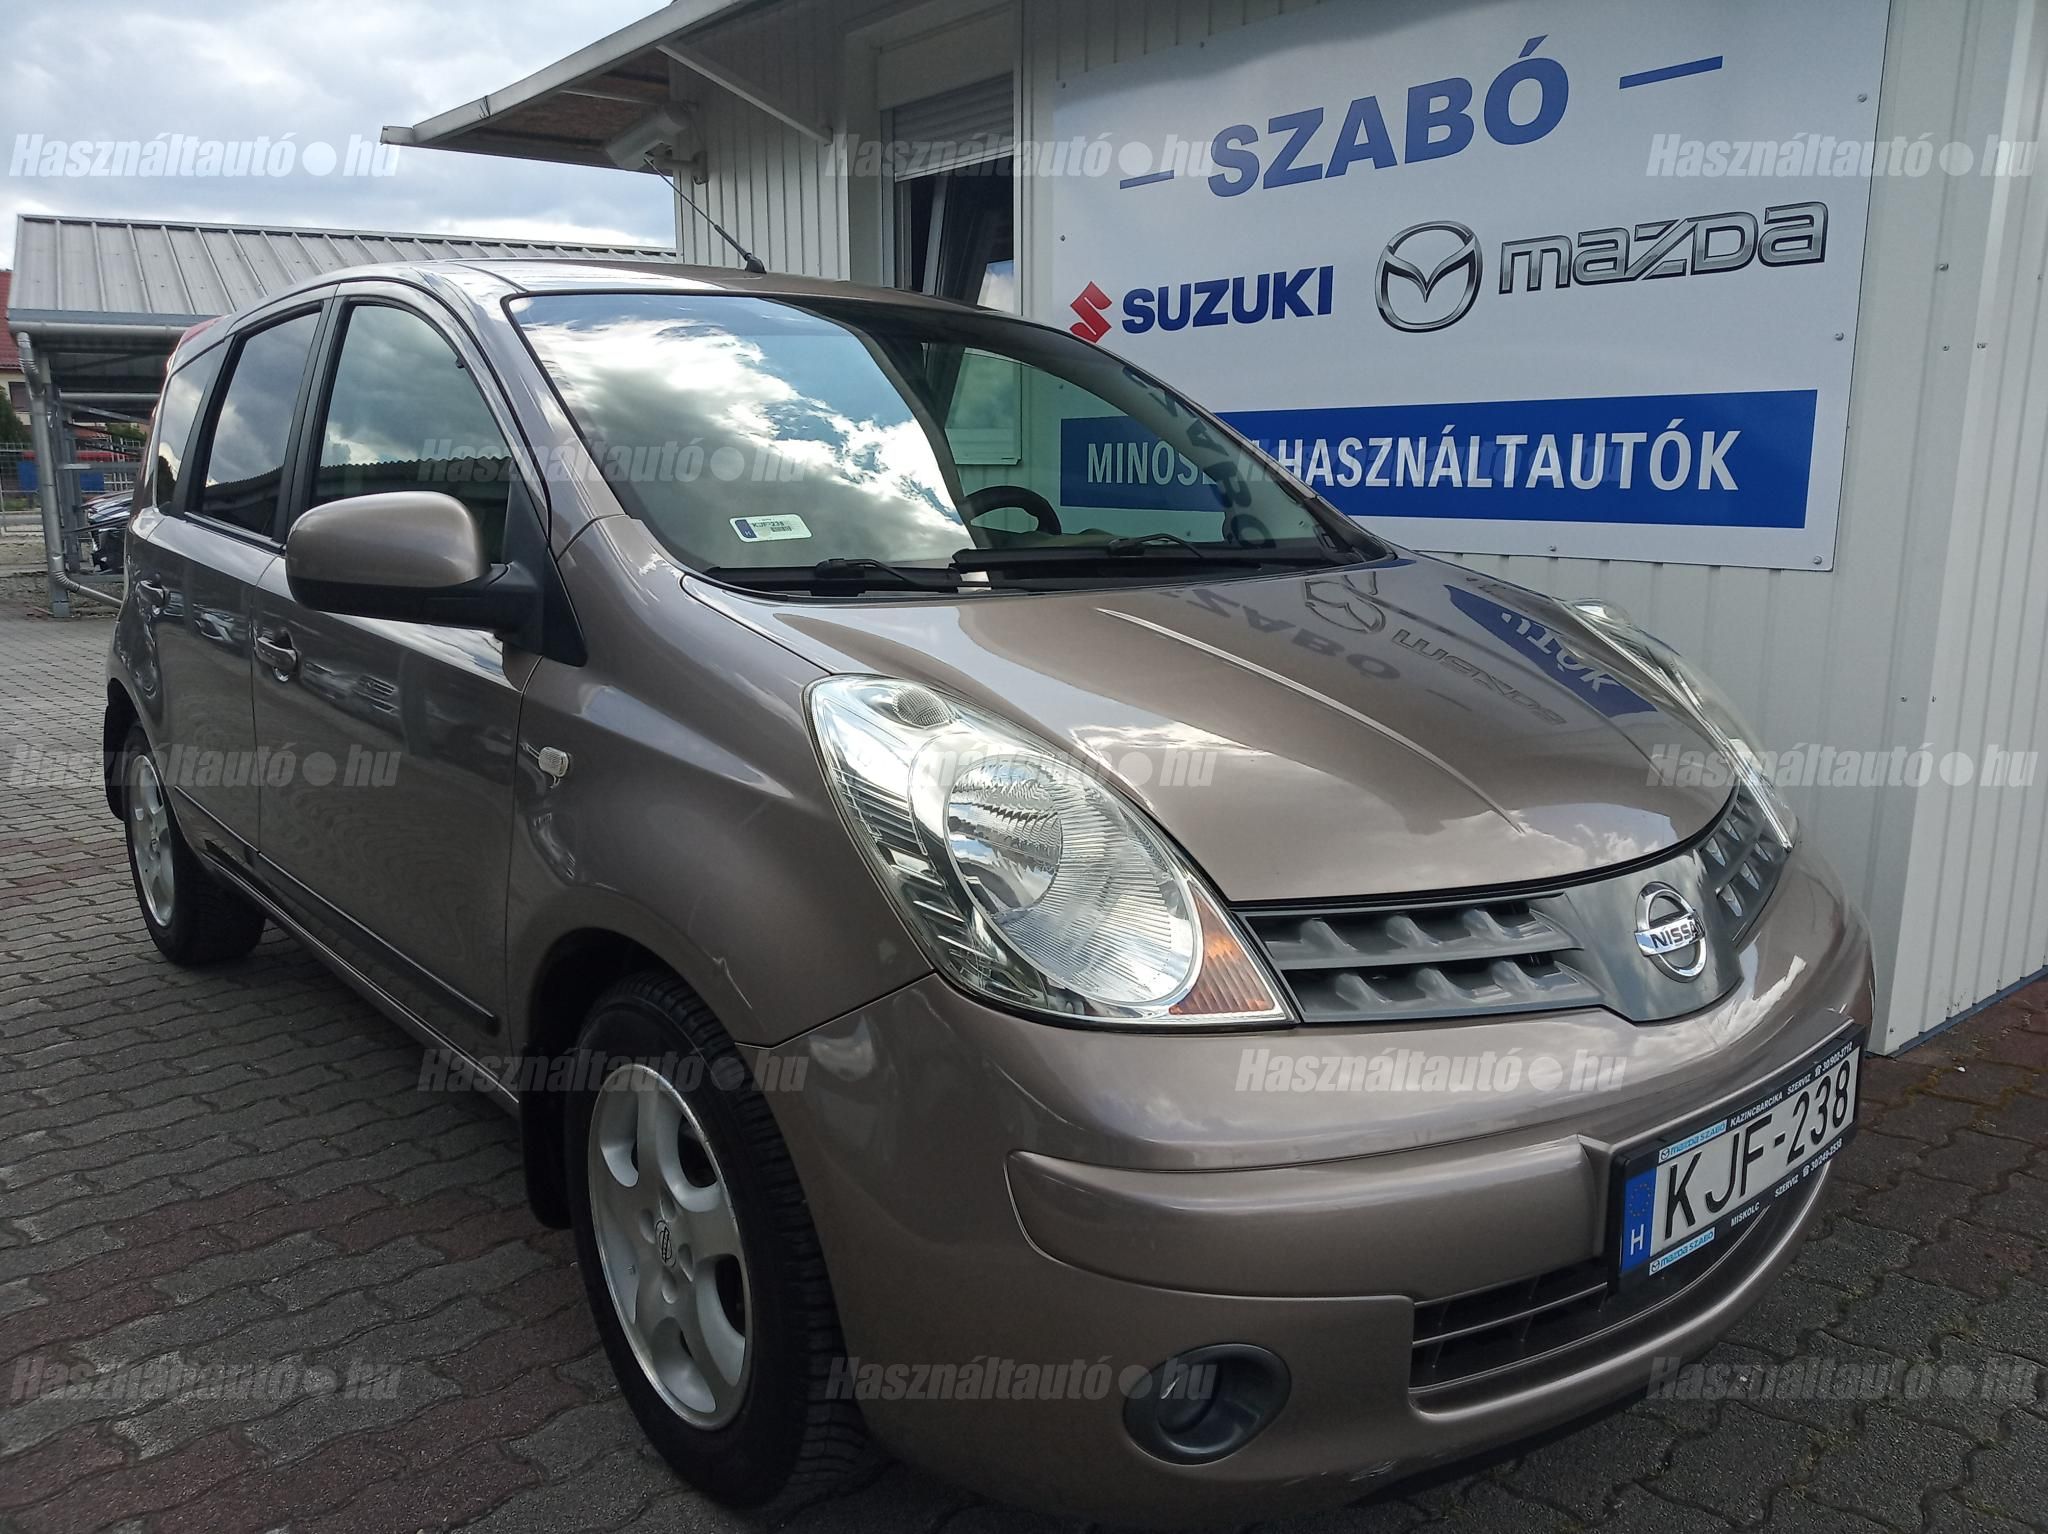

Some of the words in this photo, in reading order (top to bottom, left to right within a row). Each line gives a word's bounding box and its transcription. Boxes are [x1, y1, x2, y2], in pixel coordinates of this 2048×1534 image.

[1206, 35, 1569, 198] SZABÓ
[1121, 264, 1334, 335] SUZUKI
[1278, 418, 1741, 491] HASZNÁLTAUTÓK
[1665, 1060, 1850, 1241] KJF-238
[1630, 1223, 1645, 1256] H
[1731, 1201, 1760, 1227] MISKOLC
